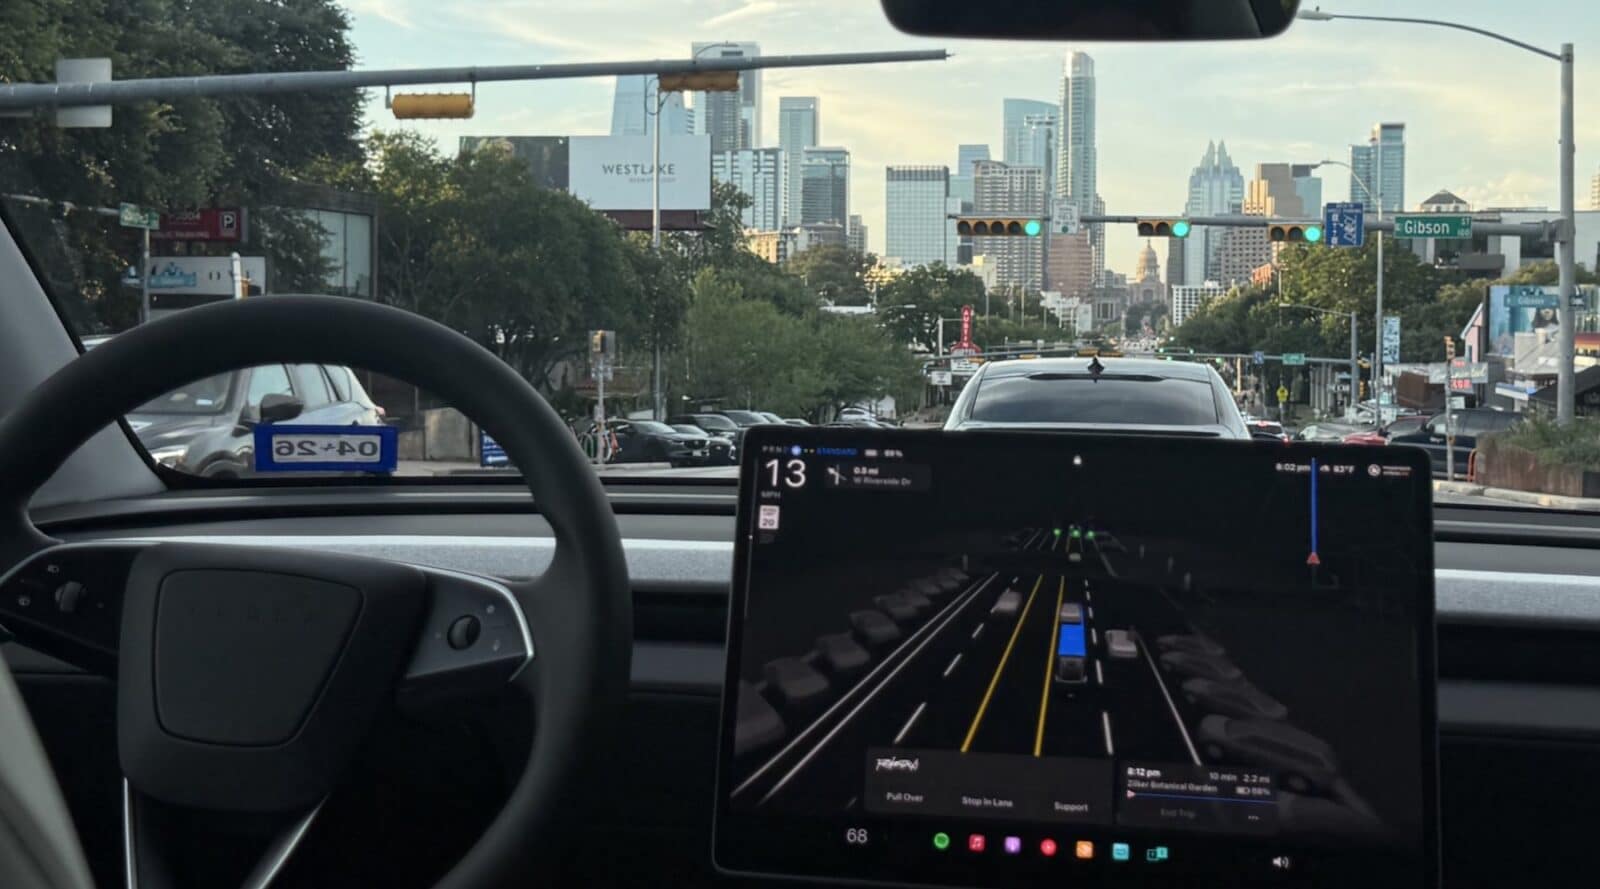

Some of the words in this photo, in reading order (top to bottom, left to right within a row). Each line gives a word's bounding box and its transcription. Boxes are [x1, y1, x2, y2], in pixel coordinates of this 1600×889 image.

[1404, 220, 1450, 234] Gibson
[765, 459, 806, 487] 13
[1146, 769, 1161, 778] pm
[886, 792, 904, 801] Pull
[905, 793, 924, 802] Over
[962, 796, 982, 807] Stop
[1054, 801, 1088, 813] Support
[846, 828, 868, 843] 68
